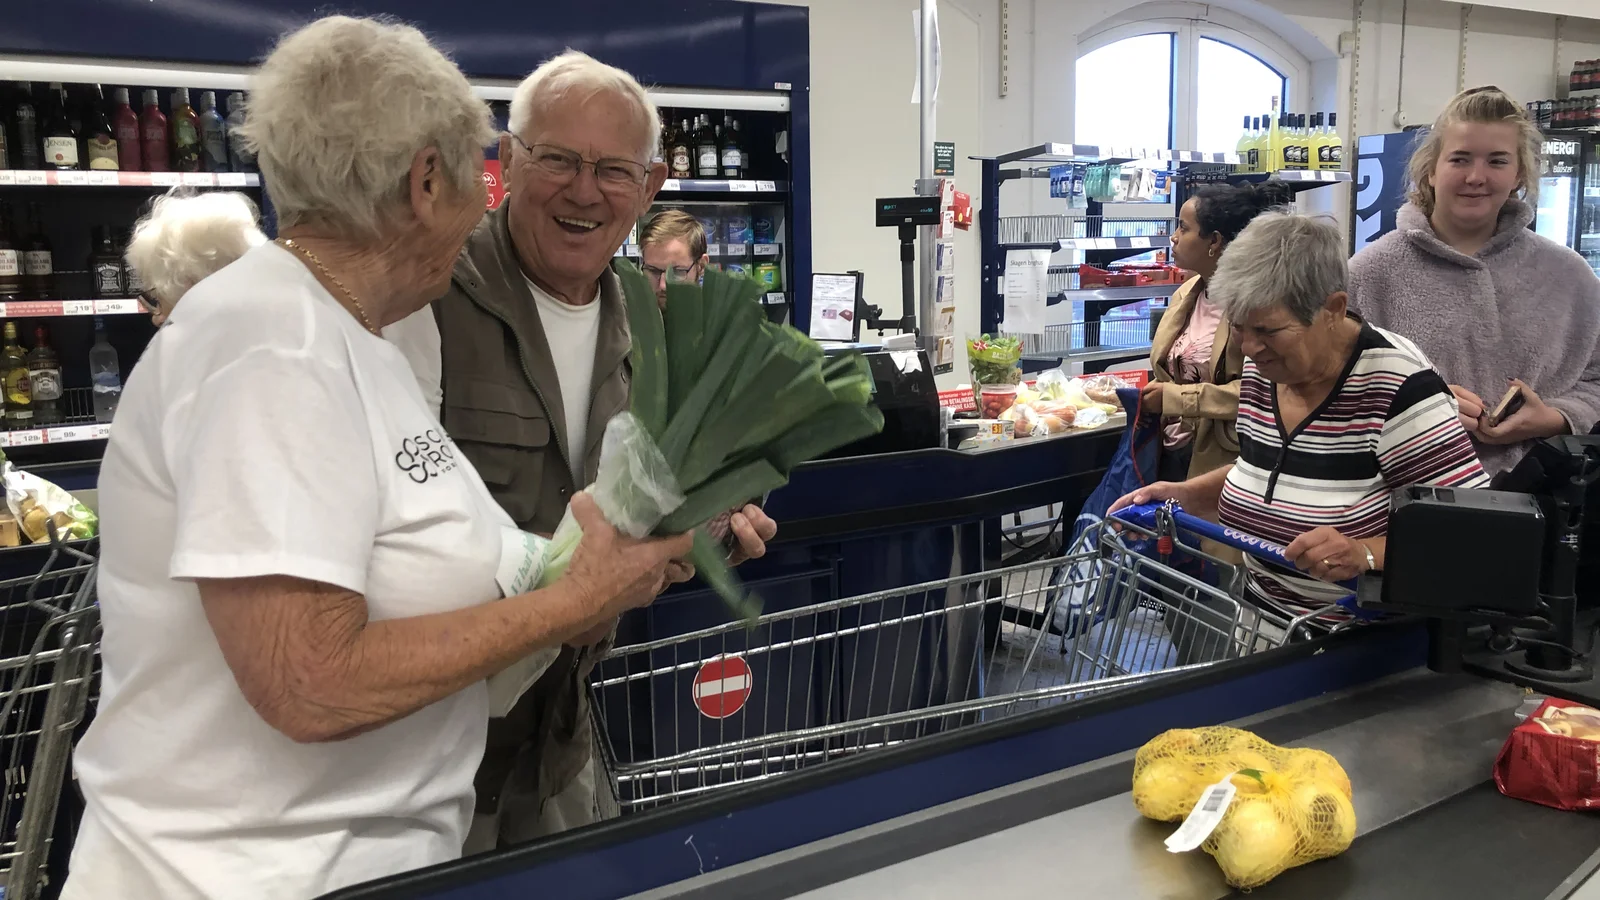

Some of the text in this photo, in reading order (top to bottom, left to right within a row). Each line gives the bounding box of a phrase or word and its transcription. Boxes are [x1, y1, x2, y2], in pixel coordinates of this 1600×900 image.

[45, 137, 73, 148] JENSEN
[1540, 141, 1576, 155] ENERGI
[1552, 165, 1574, 174] Booster
[948, 396, 975, 405] BETALINGSK
